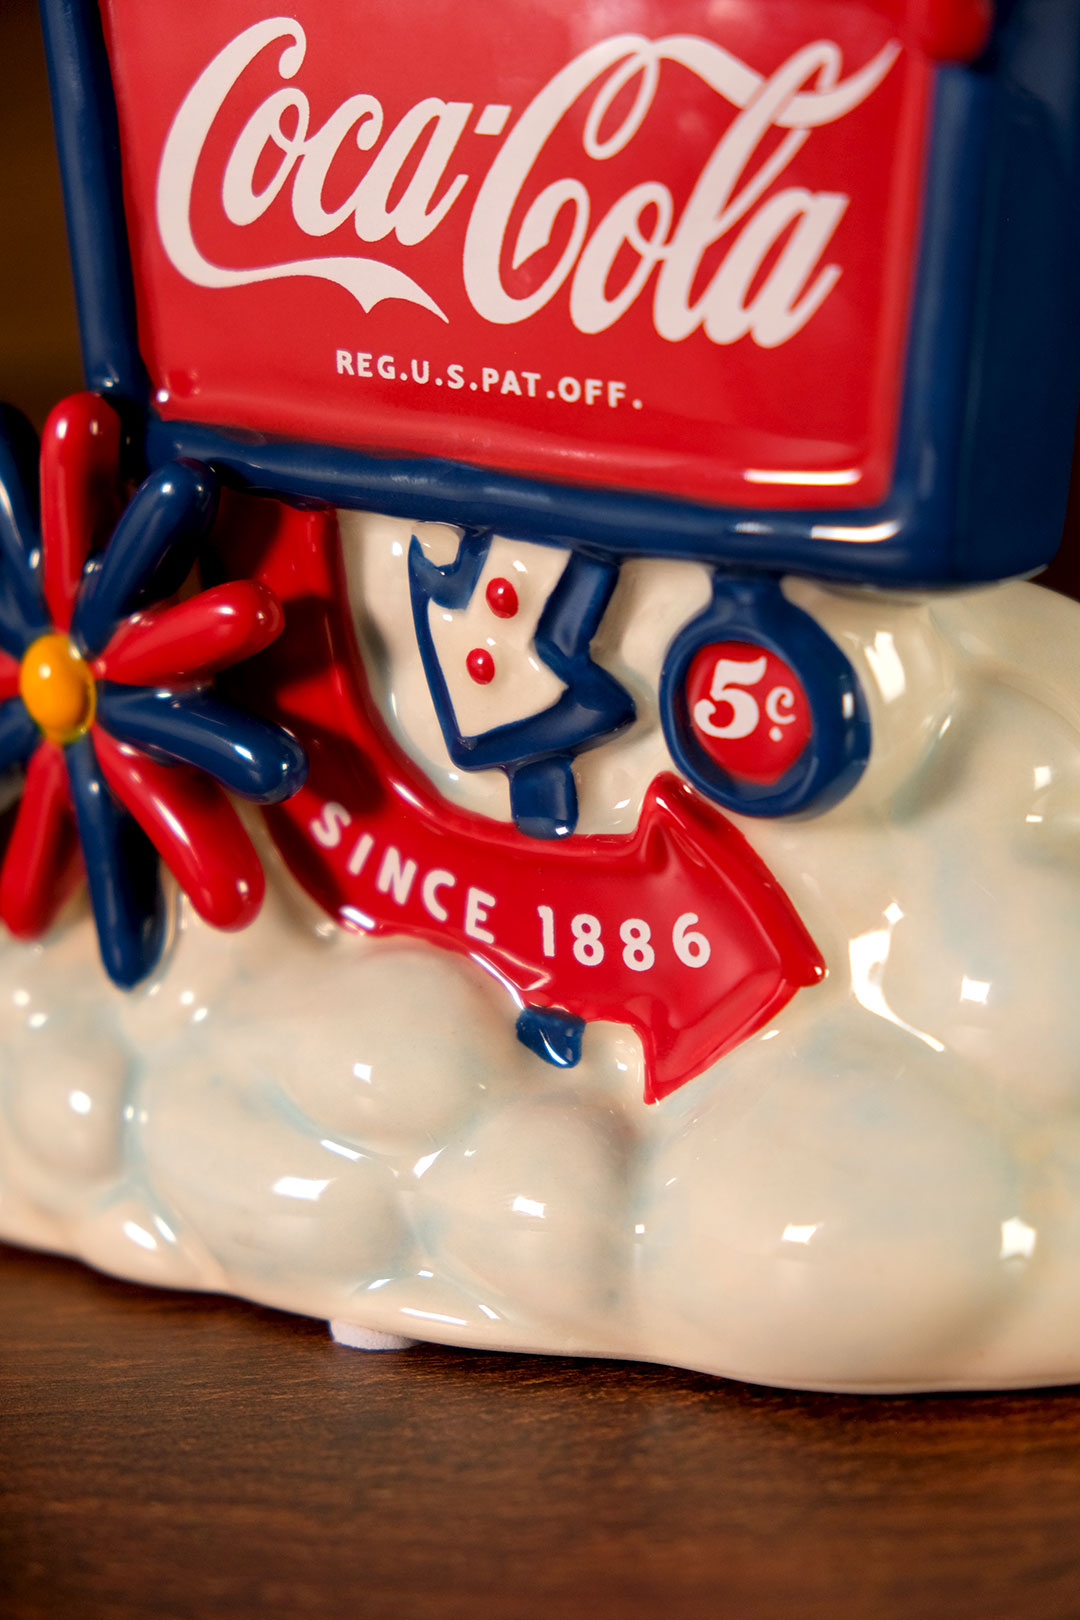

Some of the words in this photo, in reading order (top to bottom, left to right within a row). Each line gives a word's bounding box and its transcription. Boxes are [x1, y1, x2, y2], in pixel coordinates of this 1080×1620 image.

[156, 16, 901, 348] Coca-Cola
[309, 801, 497, 946] SINCE
[537, 905, 712, 973] 1886
